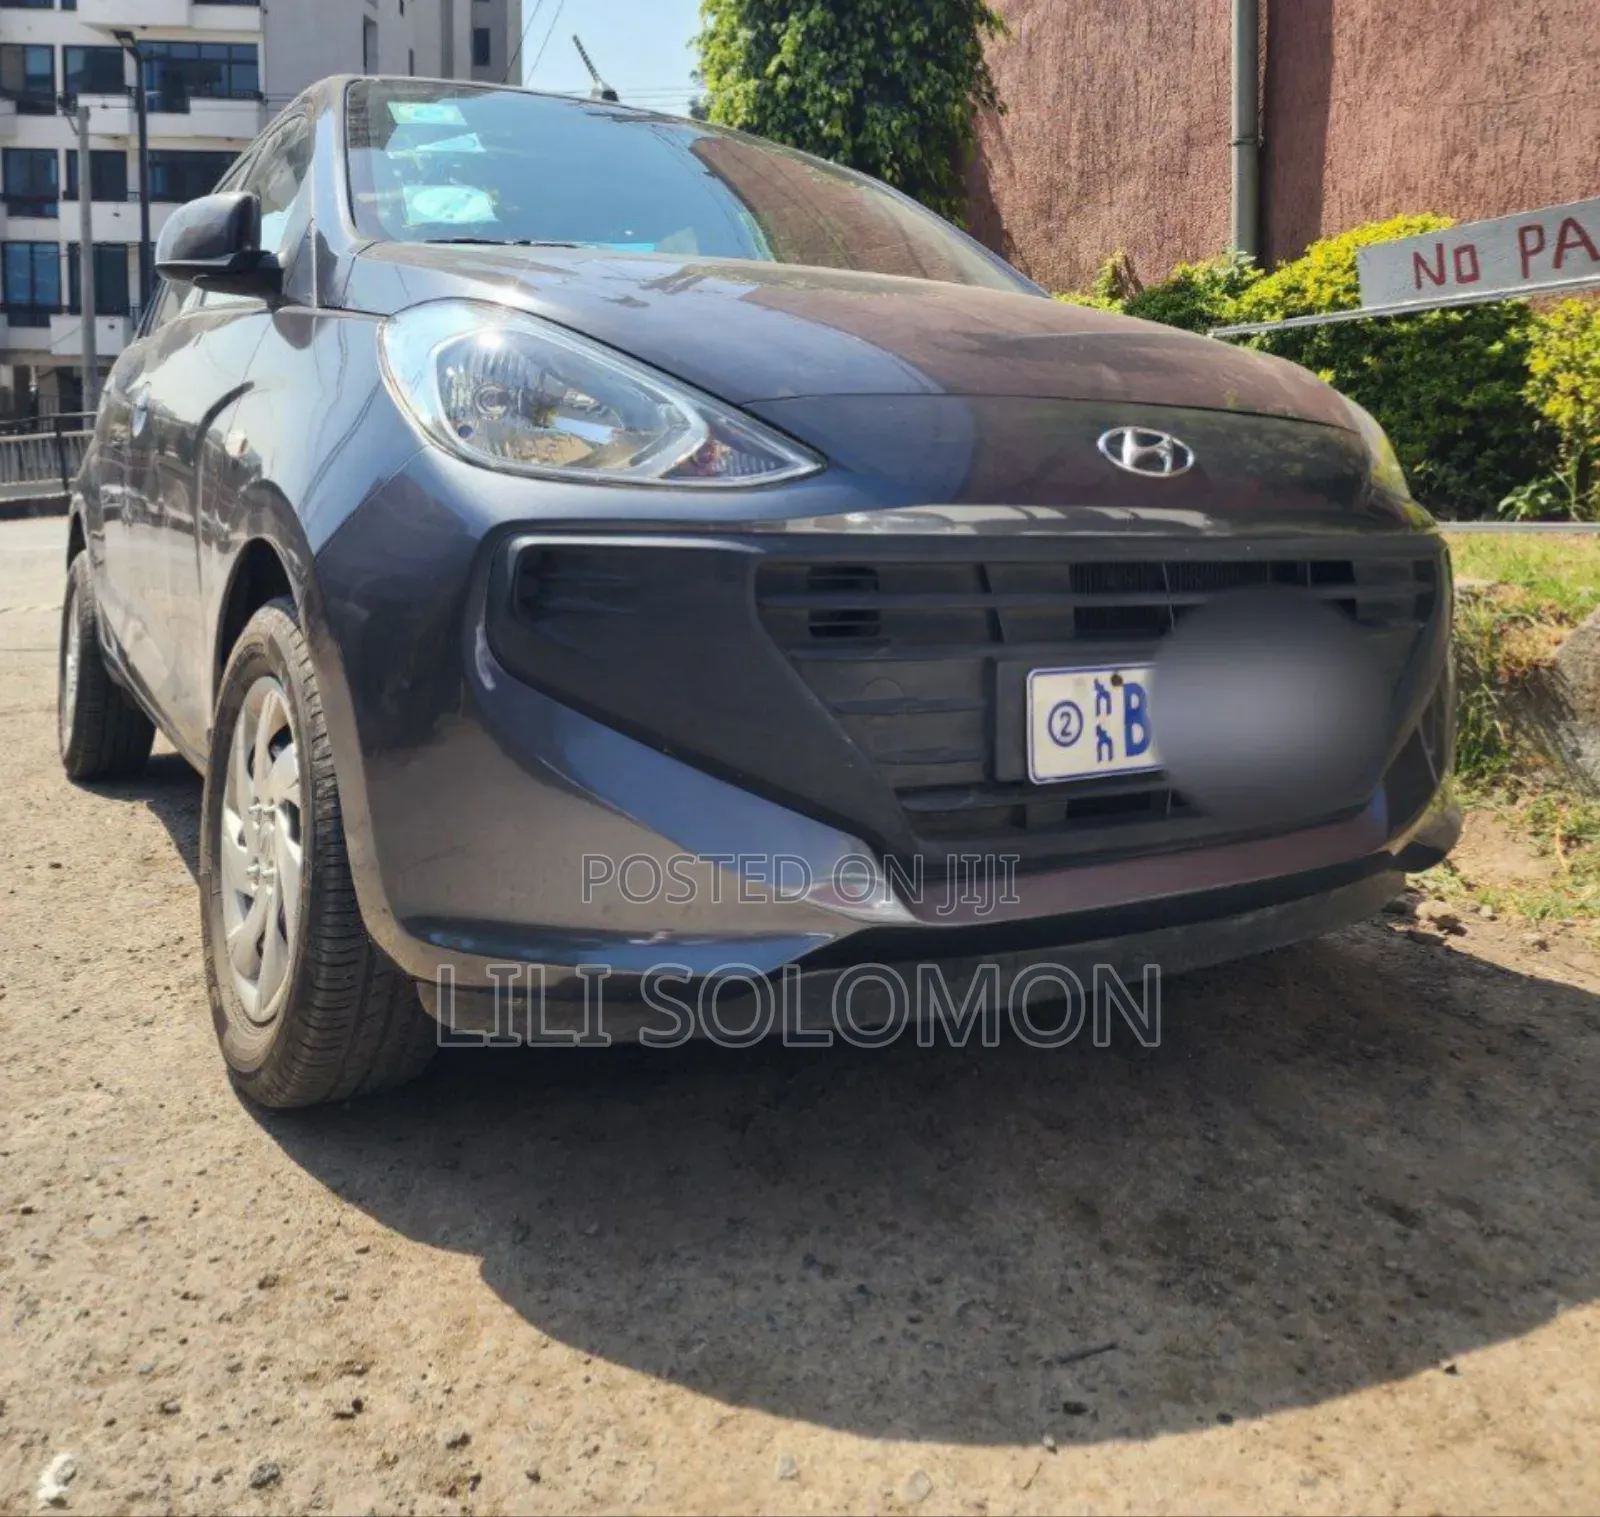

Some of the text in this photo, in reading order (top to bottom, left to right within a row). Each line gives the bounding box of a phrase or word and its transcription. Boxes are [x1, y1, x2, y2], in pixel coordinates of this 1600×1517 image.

[1413, 216, 1600, 290] NO PA
[1123, 682, 1152, 757] B
